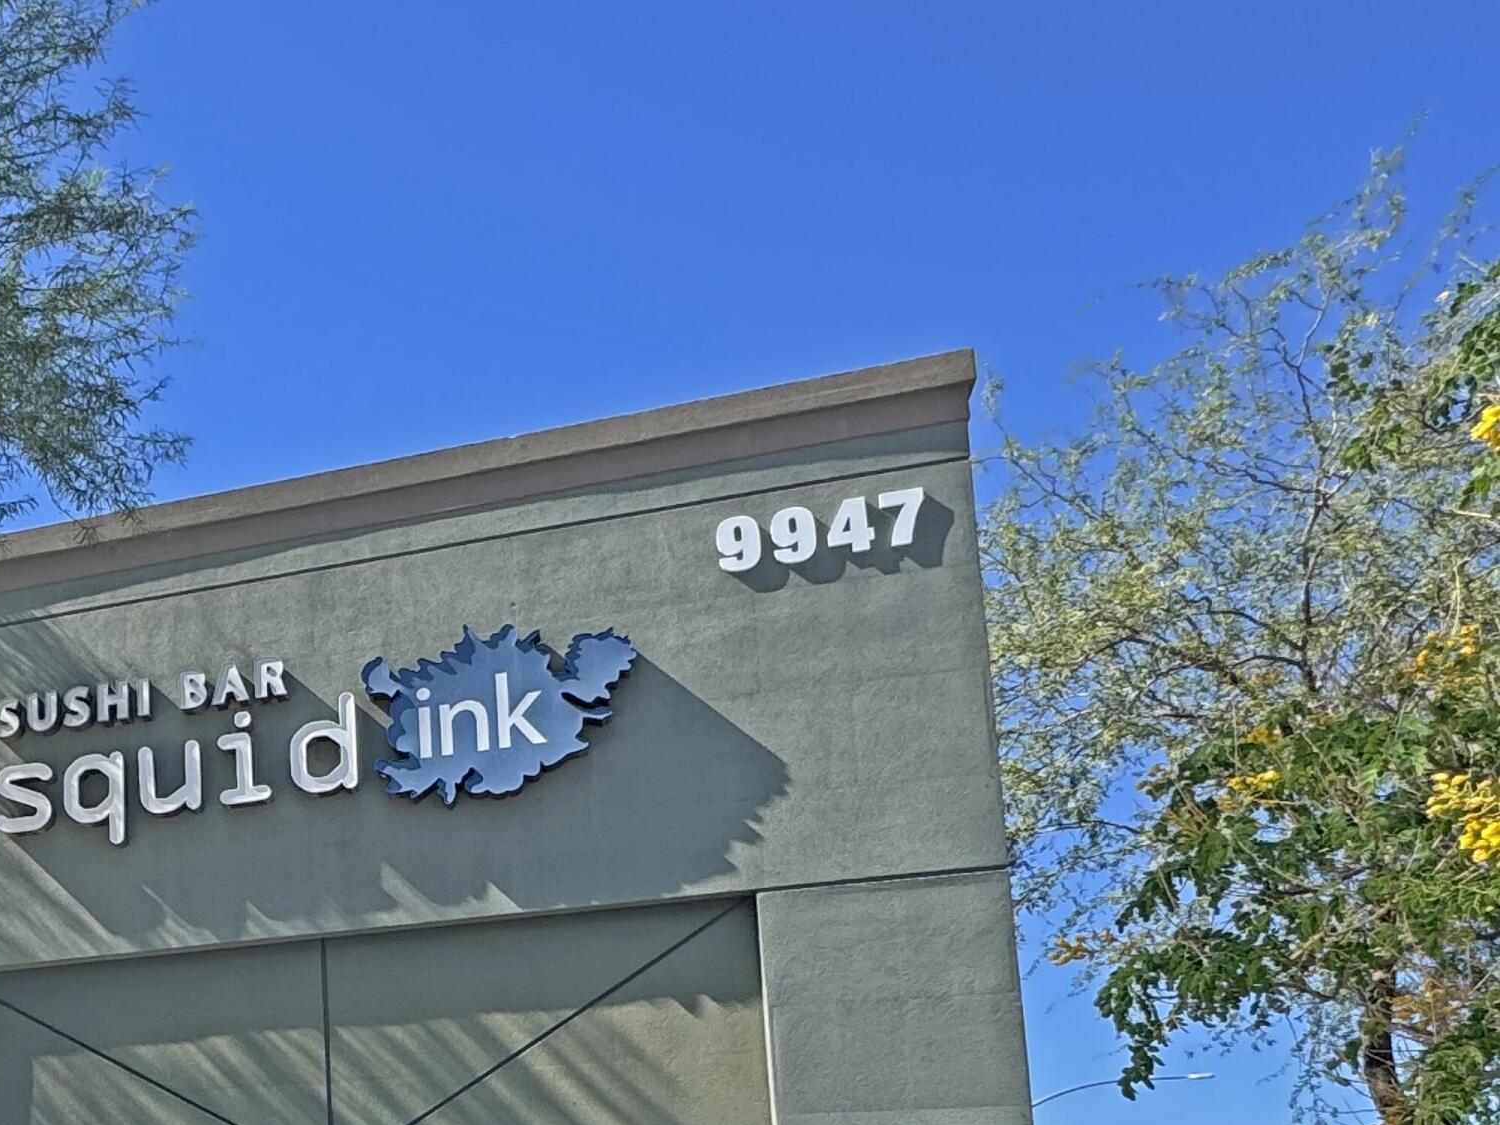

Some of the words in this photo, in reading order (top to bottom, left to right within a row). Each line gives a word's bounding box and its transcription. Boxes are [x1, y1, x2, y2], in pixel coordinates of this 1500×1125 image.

[716, 487, 924, 572] 9947
[179, 657, 288, 711] BAR
[416, 672, 548, 758] ink
